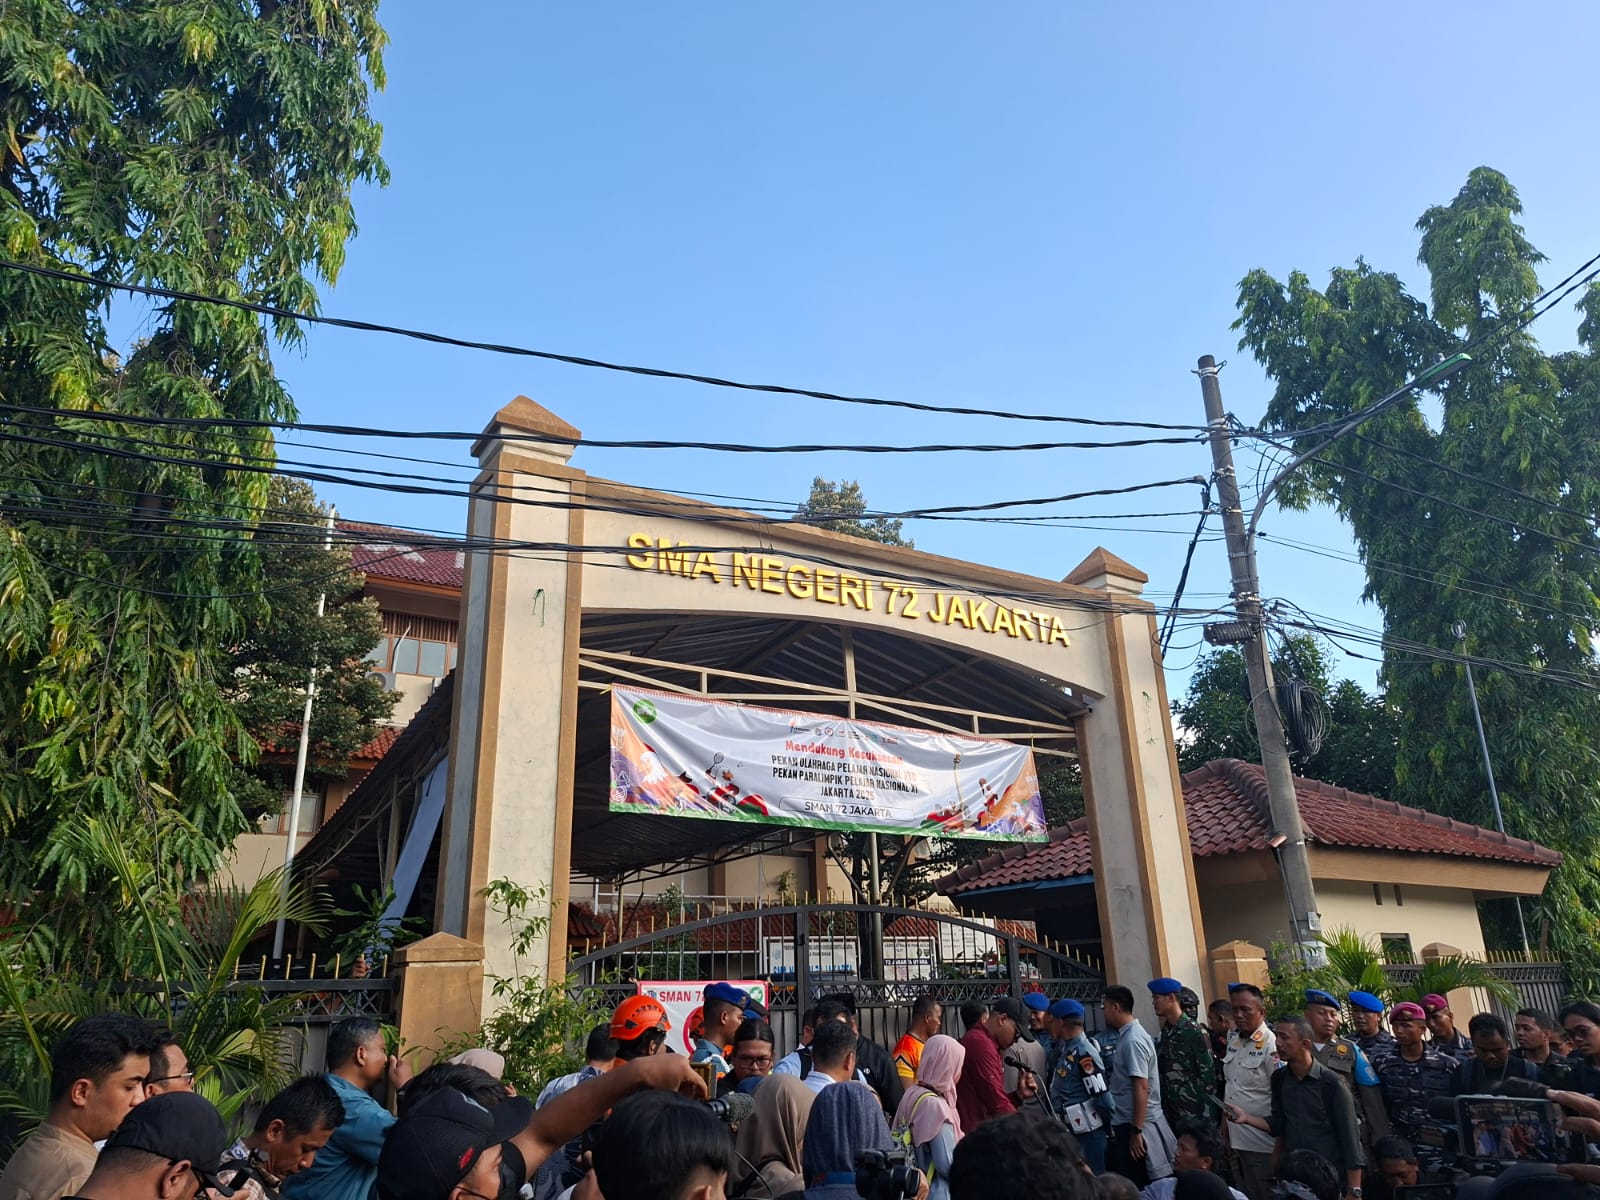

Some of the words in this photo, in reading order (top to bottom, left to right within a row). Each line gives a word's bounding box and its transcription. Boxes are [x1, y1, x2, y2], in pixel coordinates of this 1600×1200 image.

[626, 532, 721, 583] SMA
[732, 552, 873, 611] NEGERI
[880, 581, 921, 619] 72
[927, 592, 1071, 648] JAKARTA
[785, 740, 845, 759] Mendukung
[771, 755, 798, 767] PEKAN
[799, 758, 836, 771] OLAHRAGA
[837, 763, 868, 774] PELAJAR
[772, 767, 798, 780] PEKAN
[799, 771, 843, 785] PARALIMPIK
[876, 779, 910, 793] NASIONAL
[820, 786, 854, 799] JAKARTA
[804, 801, 833, 813] SMAN
[849, 805, 893, 818] JAKARTA
[659, 990, 692, 1003] SMAN
[1082, 1072, 1108, 1096] PM
